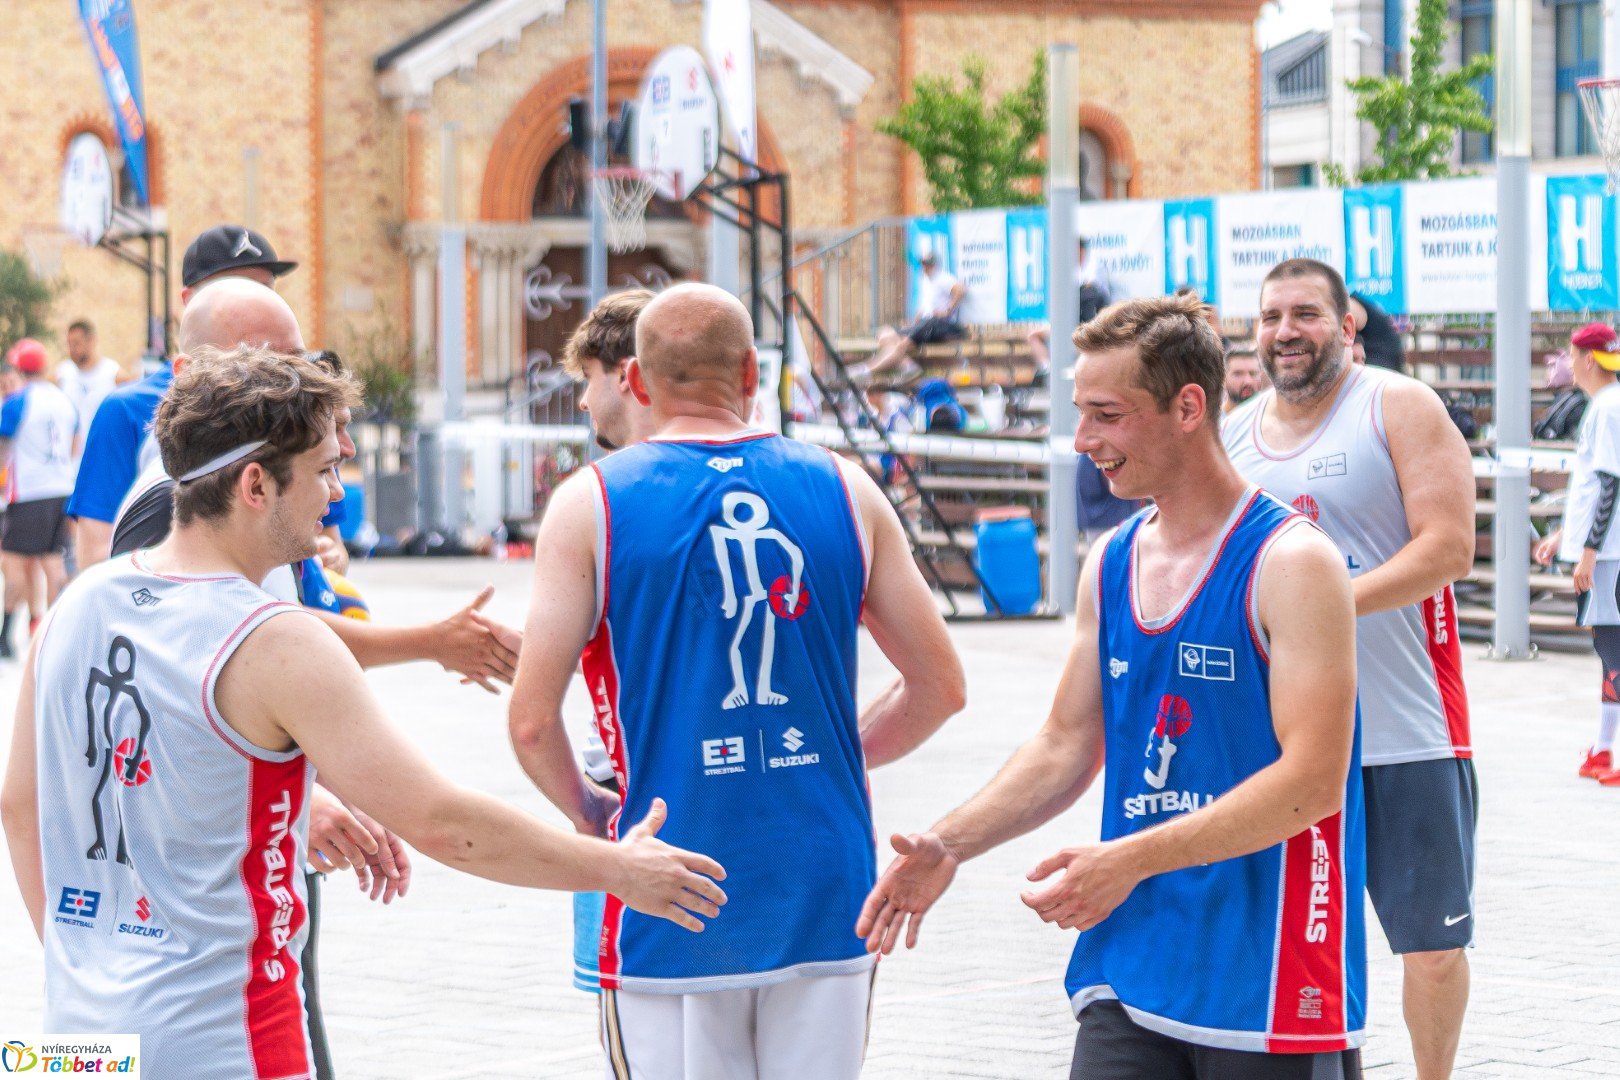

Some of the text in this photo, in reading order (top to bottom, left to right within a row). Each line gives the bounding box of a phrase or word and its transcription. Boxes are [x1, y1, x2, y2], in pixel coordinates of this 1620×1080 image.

[1232, 222, 1301, 240] MOZGÁSBAN
[1420, 211, 1498, 232] MOZGÁSBAN
[1356, 205, 1392, 278] H
[1560, 195, 1602, 271] H
[1013, 226, 1044, 291] H
[1169, 215, 1206, 287] H
[1232, 249, 1278, 266] TARTJUK
[1420, 242, 1471, 259] TARTJUK
[1477, 240, 1484, 256] A
[769, 753, 820, 768] SUZUKI
[118, 923, 164, 938] SUZUKI
